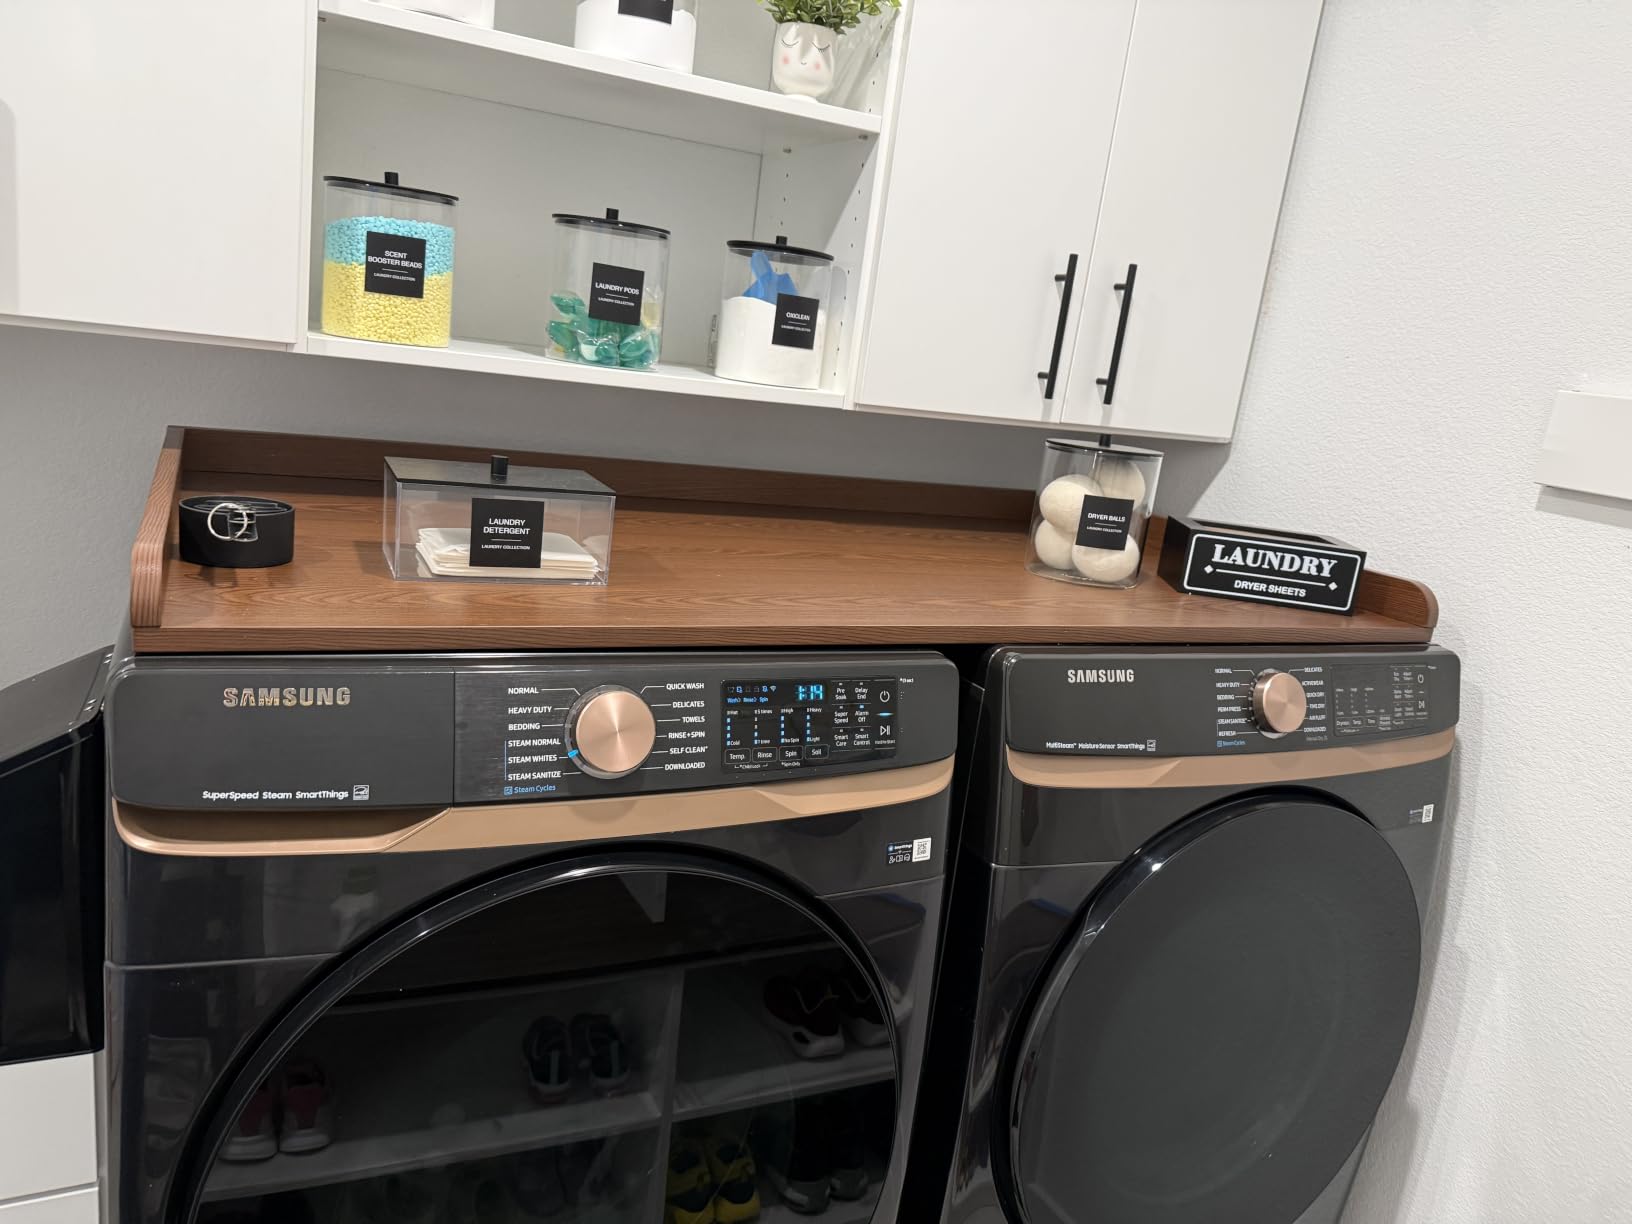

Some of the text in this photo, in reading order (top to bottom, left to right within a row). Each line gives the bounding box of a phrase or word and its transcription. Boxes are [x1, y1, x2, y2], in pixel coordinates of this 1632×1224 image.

[368, 256, 400, 265] BOOSTER
[595, 282, 639, 295] LAUNDRY PODS
[489, 518, 525, 526] LAUNDRY
[1212, 544, 1337, 577] LAUNDRY
[1234, 579, 1306, 597] DRYER SHEETS
[1068, 669, 1134, 683] SAMSUNG
[223, 687, 350, 707] SAMSUNG
[665, 762, 705, 770] DOWNLOADED
[532, 771, 561, 779] SANITIZE
[536, 784, 556, 793] Cycles
[202, 790, 259, 801] SuperSpeed
[262, 791, 292, 799] Steam
[295, 790, 349, 800] SmartThings
